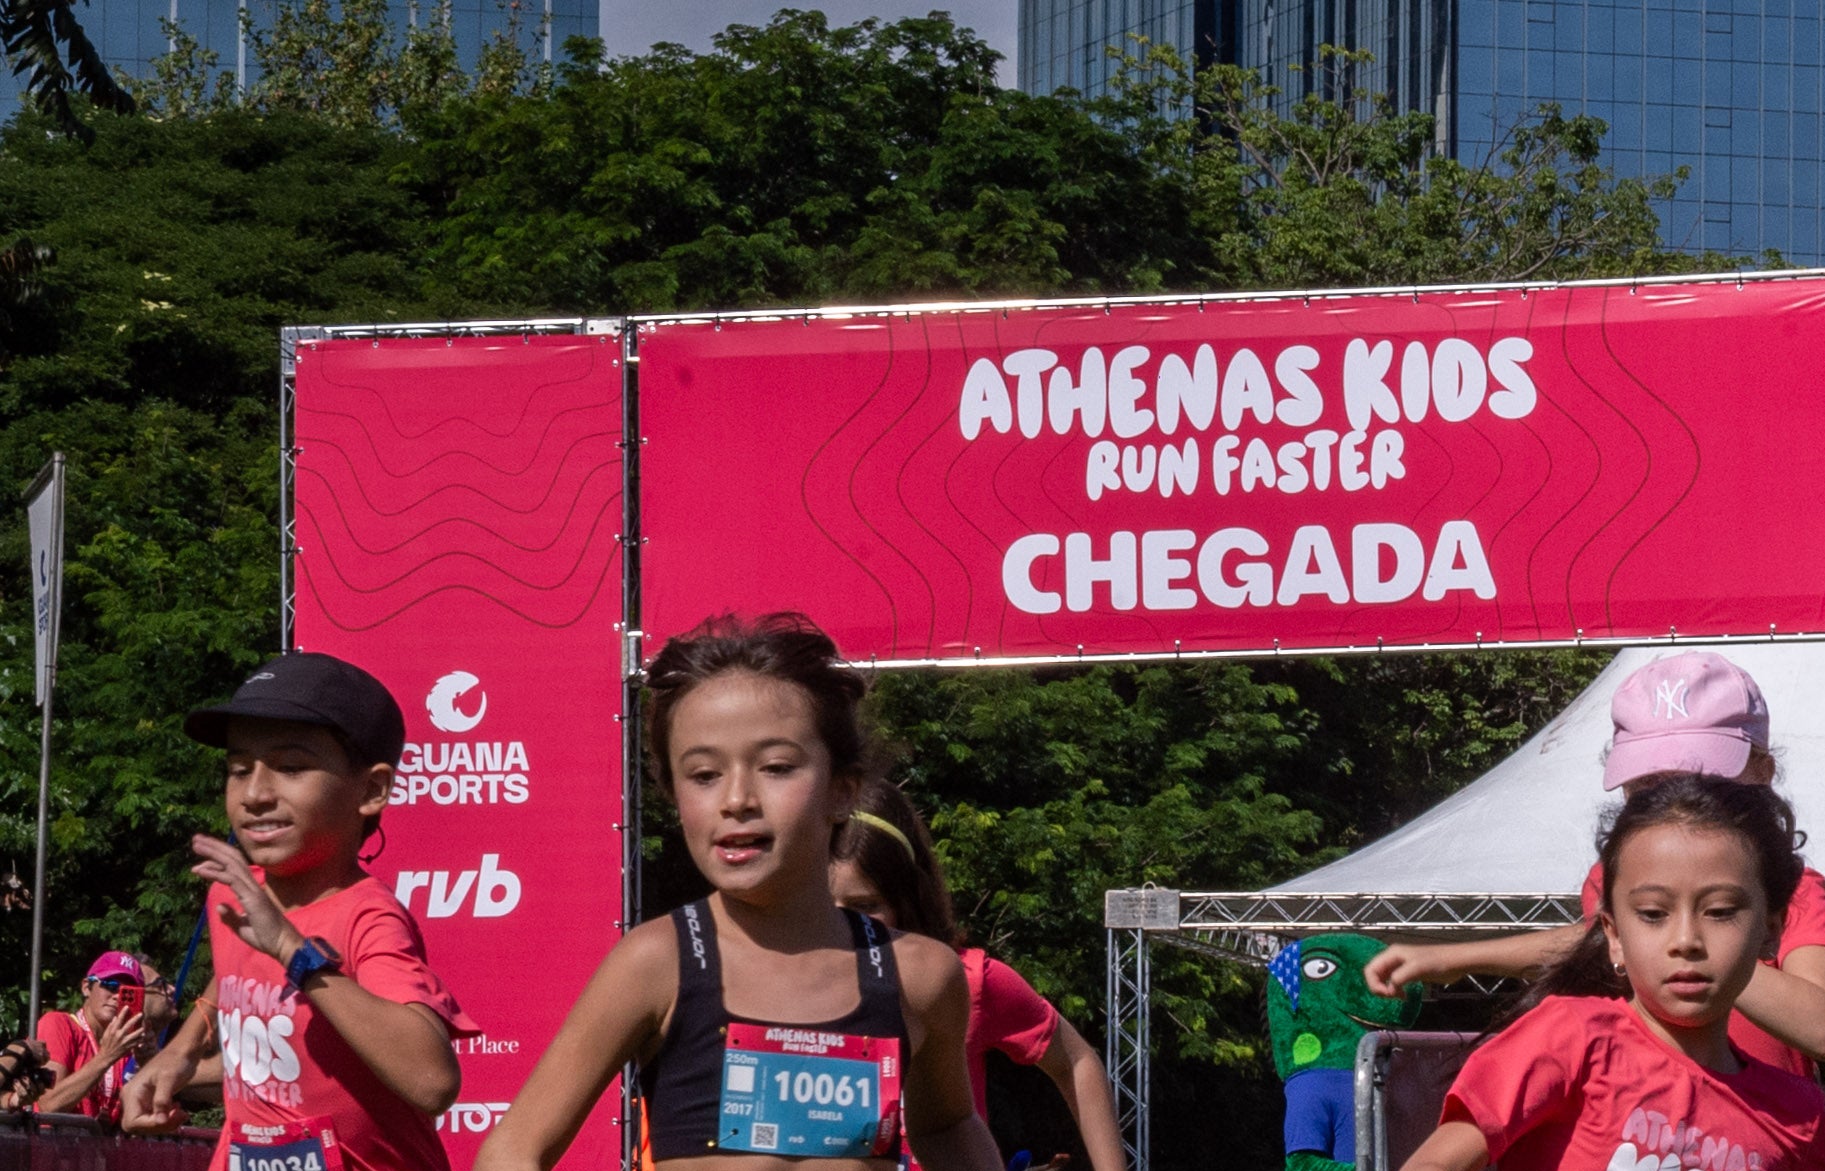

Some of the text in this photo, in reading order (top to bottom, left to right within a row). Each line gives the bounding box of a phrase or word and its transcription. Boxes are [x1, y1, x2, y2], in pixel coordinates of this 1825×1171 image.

[959, 337, 1538, 441] ATHENAS KIDS
[1086, 429, 1406, 501] RUN FASTER
[1002, 520, 1497, 615] CHEGADA
[397, 741, 530, 773] GUANA
[387, 773, 530, 806] SPORTS
[394, 853, 522, 919] rvb
[468, 1034, 520, 1055] Place
[765, 1028, 845, 1047] ATHENAS KIDS
[726, 1053, 759, 1065] 250m
[774, 1070, 871, 1108] 10061
[724, 1101, 753, 1116] 2017
